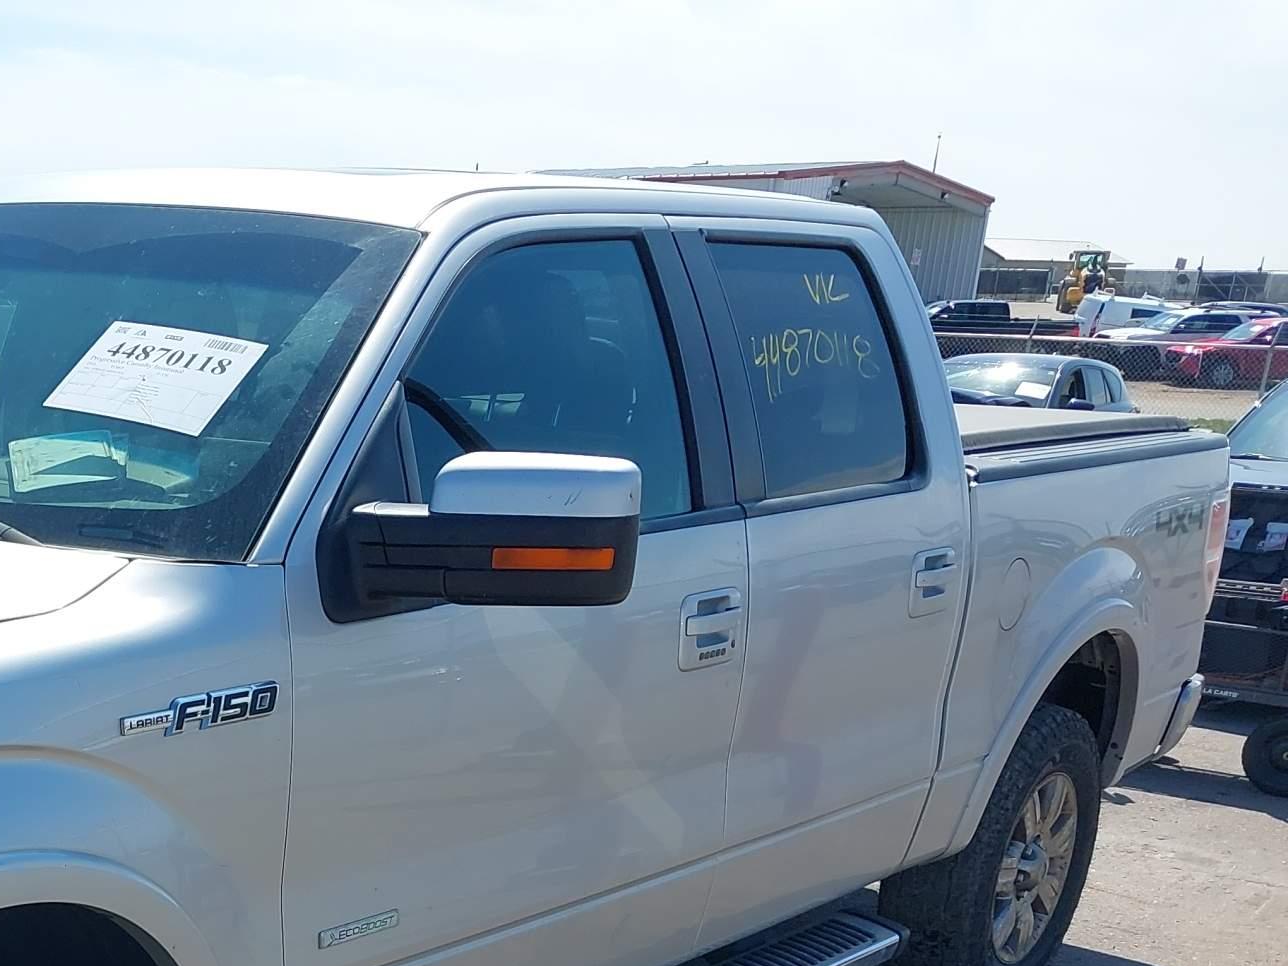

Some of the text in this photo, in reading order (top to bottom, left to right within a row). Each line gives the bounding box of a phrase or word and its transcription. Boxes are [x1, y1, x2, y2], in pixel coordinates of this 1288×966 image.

[107, 341, 233, 376] 44870118
[750, 328, 880, 403] 44870118
[128, 680, 280, 735] LARIAT F-150
